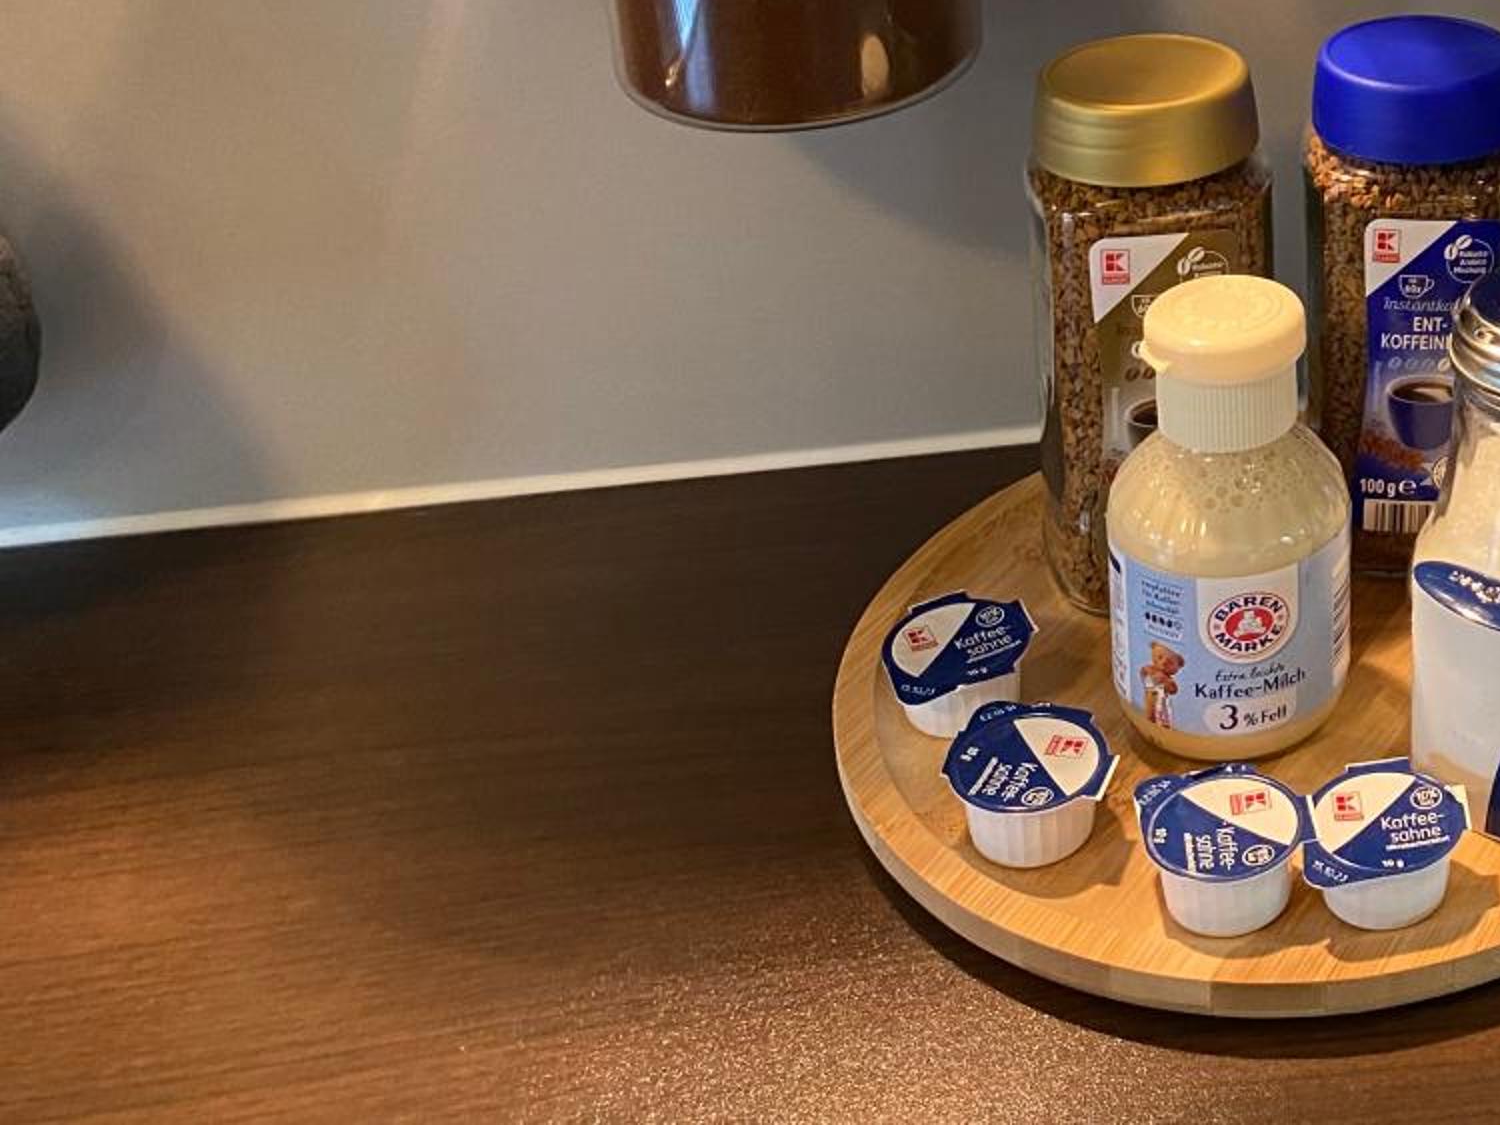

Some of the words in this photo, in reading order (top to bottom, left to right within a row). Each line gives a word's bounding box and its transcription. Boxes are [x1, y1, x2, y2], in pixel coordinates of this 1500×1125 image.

[1412, 316, 1449, 332] ENT-
[1359, 478, 1385, 494] 100
[1387, 482, 1396, 498] g
[1214, 622, 1283, 652] MARKE
[1194, 668, 1307, 699] Kaffee-Milch
[1218, 704, 1239, 730] 3
[1380, 810, 1446, 831] Kaffee-
[1390, 826, 1442, 844] sahne
[1195, 834, 1216, 871] sahne
